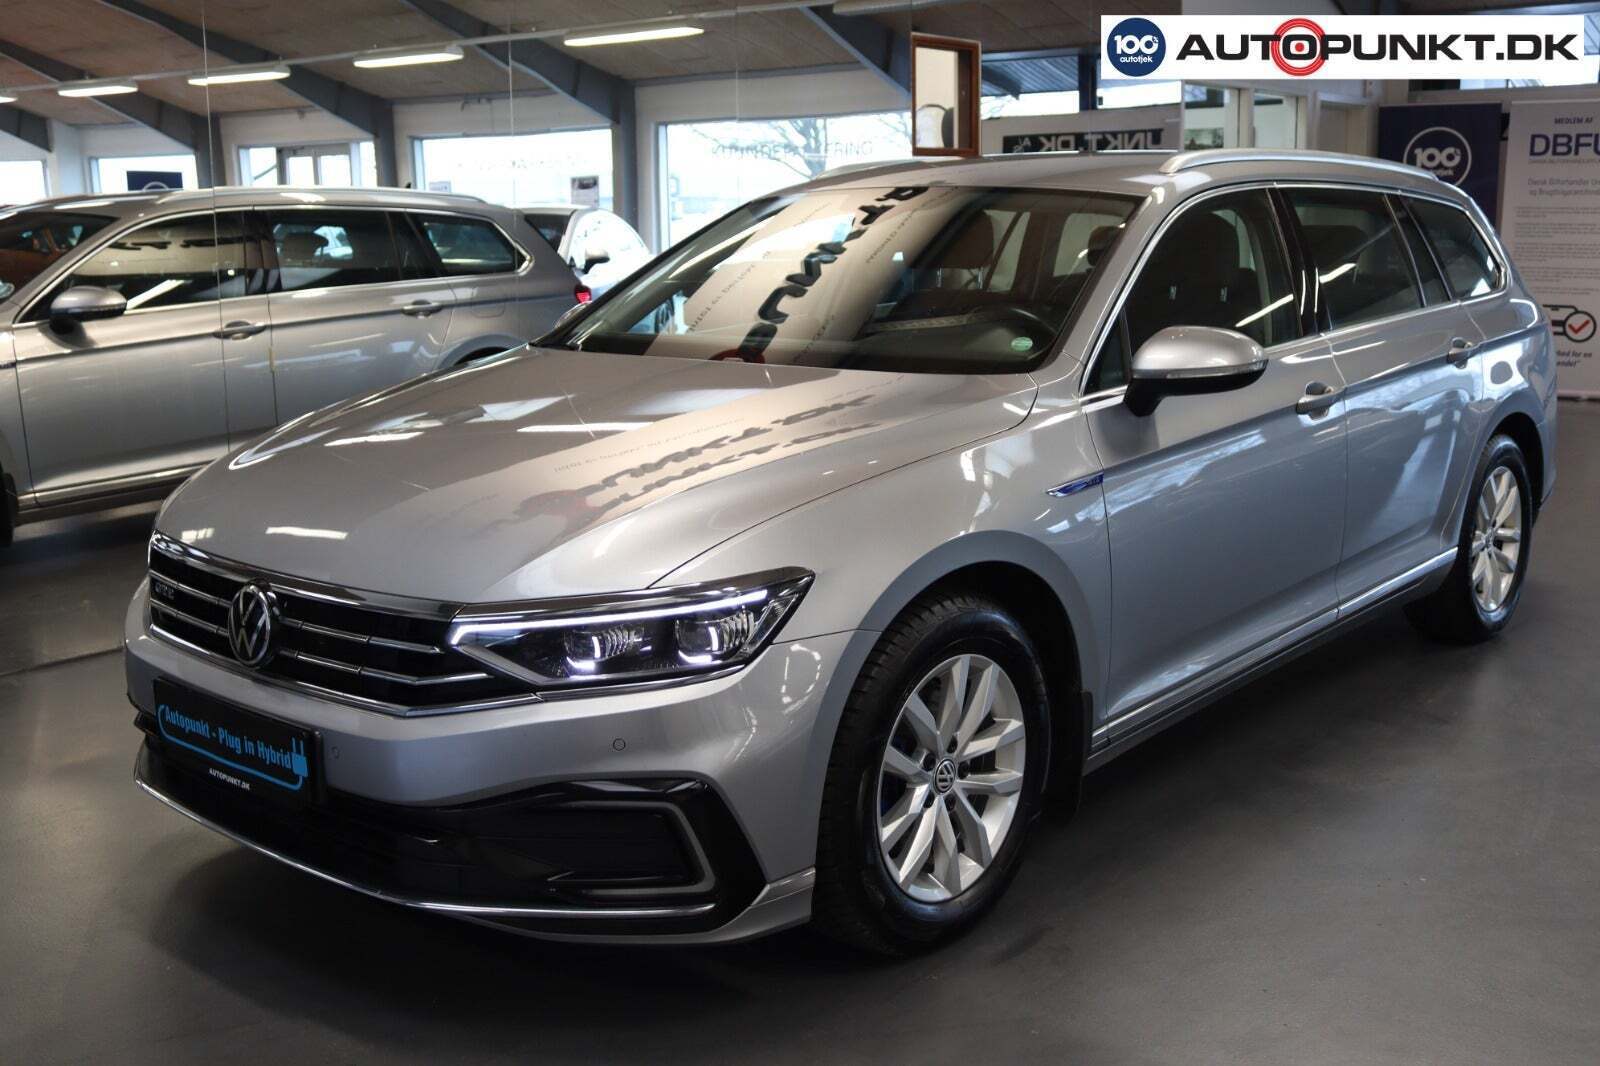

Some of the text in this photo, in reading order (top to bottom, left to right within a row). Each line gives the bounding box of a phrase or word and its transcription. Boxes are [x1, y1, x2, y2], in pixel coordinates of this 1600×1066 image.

[164, 706, 210, 739] Autopunkt
[218, 727, 242, 754] Plug
[243, 734, 256, 756] in
[256, 740, 294, 769] Hybrid
[208, 767, 252, 791] AUTOPUNKT.DK
